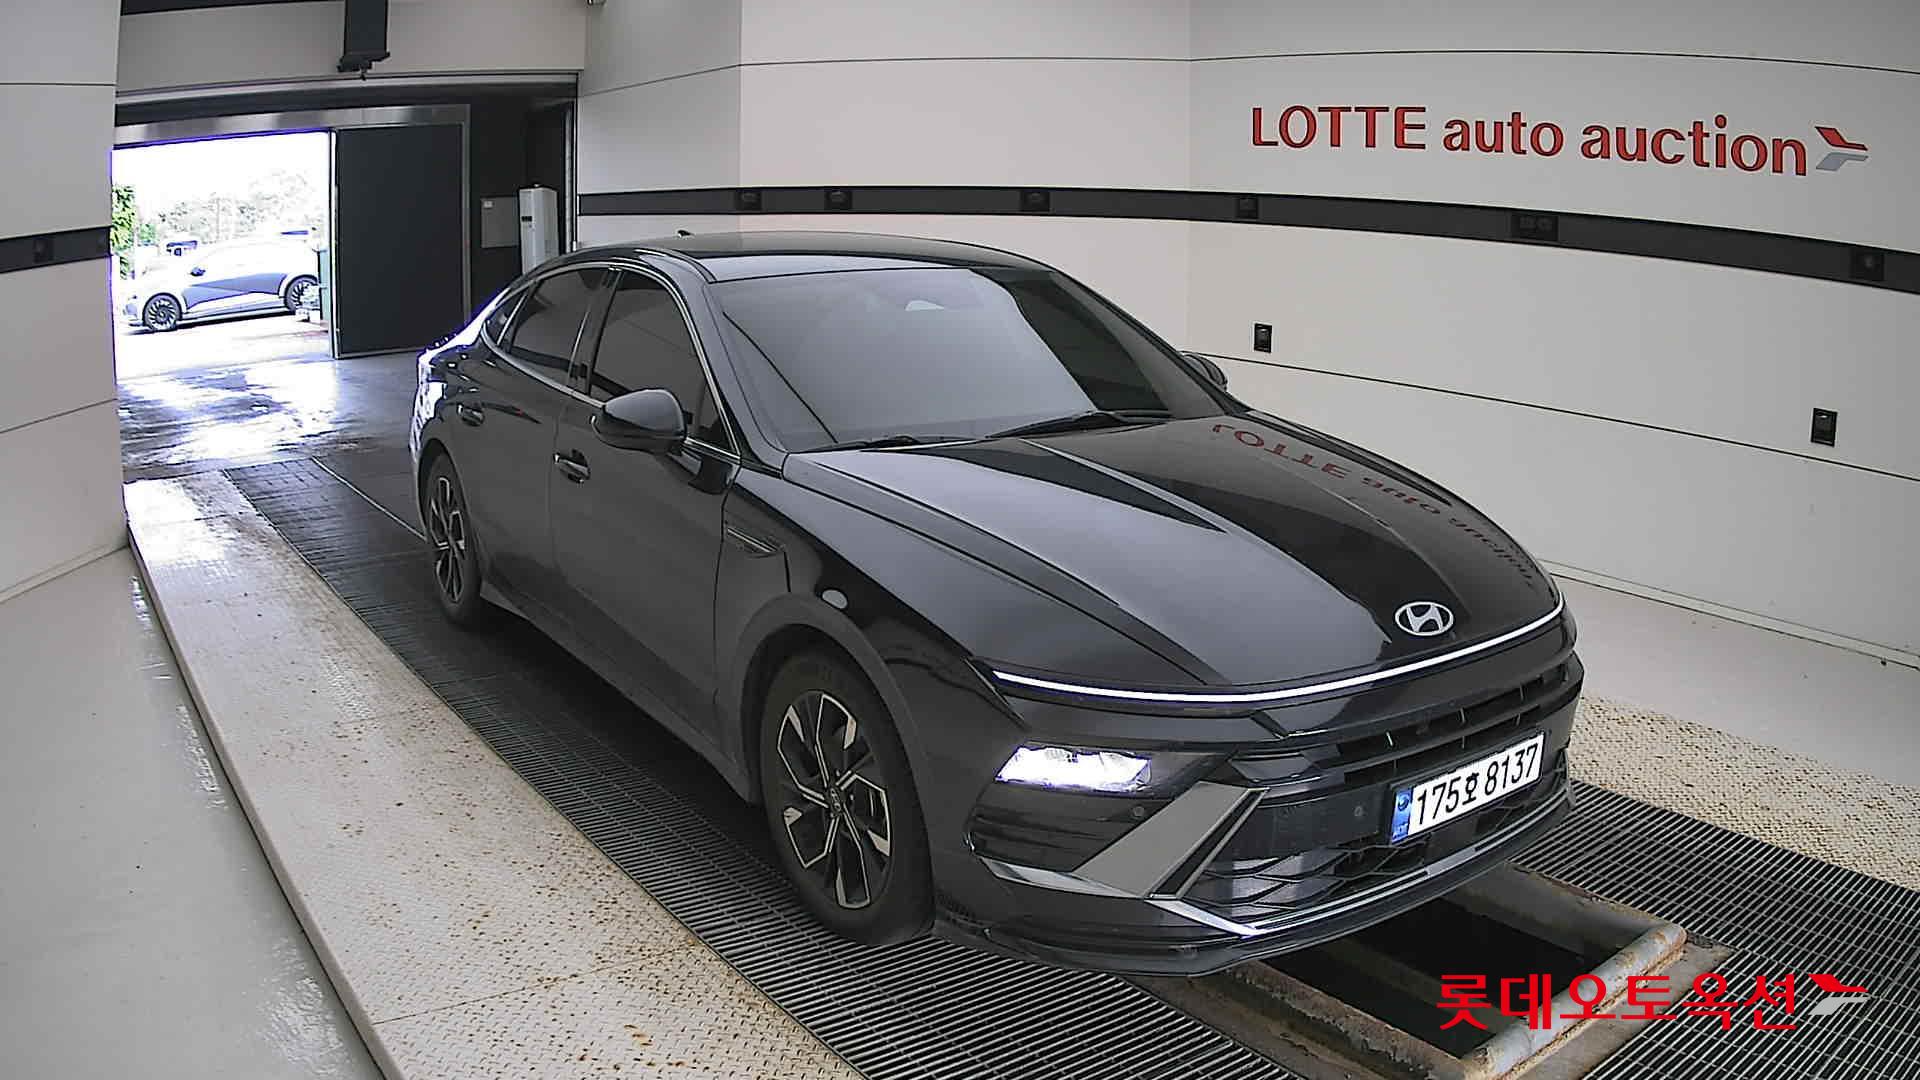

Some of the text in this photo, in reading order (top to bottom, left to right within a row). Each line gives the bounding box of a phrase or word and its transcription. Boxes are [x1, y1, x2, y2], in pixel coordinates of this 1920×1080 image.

[1252, 105, 1808, 176] LOTTE auto auction
[1484, 743, 1539, 796] 8137
